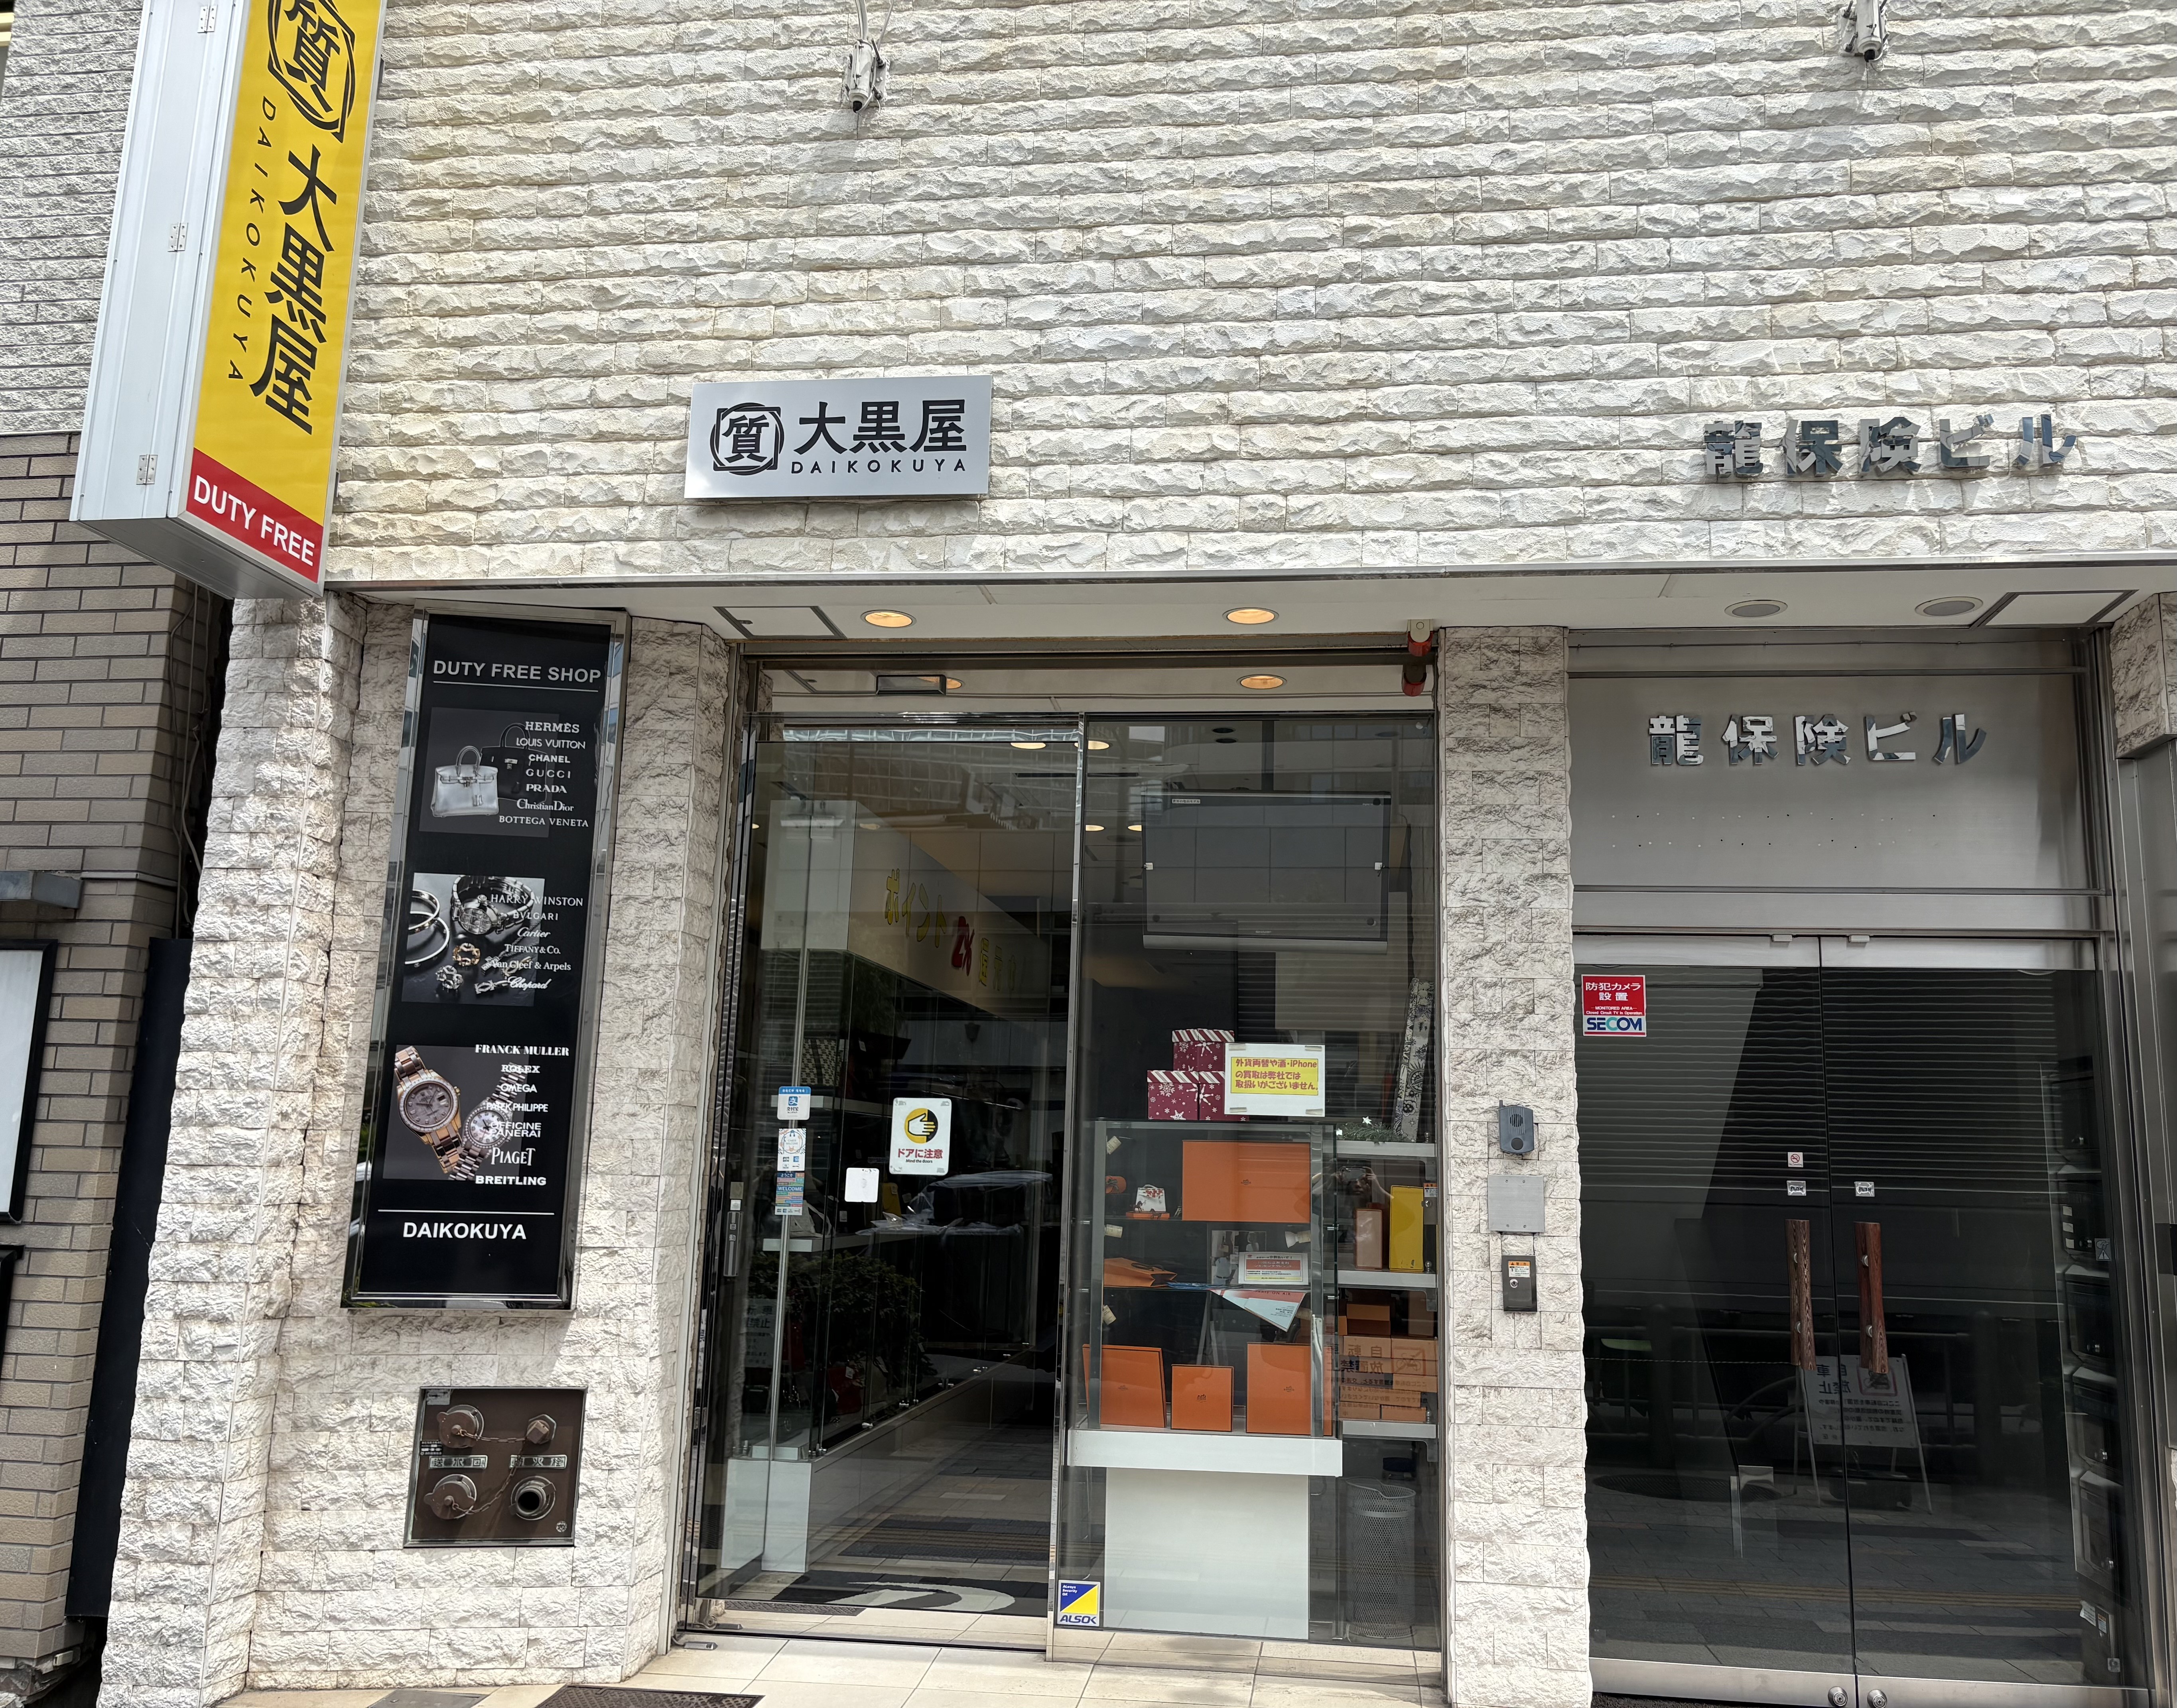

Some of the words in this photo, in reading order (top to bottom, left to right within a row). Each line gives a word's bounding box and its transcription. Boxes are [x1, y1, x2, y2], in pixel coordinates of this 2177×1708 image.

[227, 94, 277, 381] DAIKOKUYA
[249, 142, 338, 435] 大黒屋
[793, 399, 967, 455] 大黒屋
[722, 414, 769, 463] 質
[1704, 414, 2077, 475] 龍保険ビル
[791, 459, 966, 474] DAIKOKUYA
[193, 474, 256, 533] DUTY
[261, 519, 316, 567] FREE
[433, 660, 485, 677] DUTY
[491, 664, 541, 679] FREE
[548, 667, 601, 683] SHOP
[516, 737, 542, 747] LOUIS
[546, 738, 586, 750] VUITTON
[1649, 712, 1987, 766] 龍保険ビル
[528, 754, 571, 763] CHANEL
[526, 768, 571, 779] GUCCI
[526, 784, 567, 794] PRADA
[499, 815, 546, 826] BOTTEGA
[549, 817, 589, 827] VENETA
[491, 893, 528, 904] HARRY
[533, 896, 583, 907] WINSTON
[513, 912, 559, 921] BVLGARI
[517, 927, 551, 938] Cartier
[508, 960, 533, 970] Cleef
[543, 962, 571, 972] Arpels
[507, 976, 552, 990] Chopard
[1585, 982, 1641, 991] 防犯カメラ
[1599, 992, 1628, 1001] 設置
[1587, 1017, 1642, 1031] SECOM
[475, 1044, 521, 1055] FRANCK
[523, 1046, 570, 1057] MULLER
[501, 1064, 540, 1074] ROLEX
[1235, 1070, 1301, 1080] の買取は弊社では
[500, 1083, 538, 1093] OMEGA
[486, 1102, 512, 1111] PATEK
[512, 1103, 549, 1112] PHILIPPE
[490, 1121, 542, 1130] OFFICINE
[489, 1129, 541, 1138] PANERAI
[491, 1147, 536, 1166] PIAGET
[898, 1148, 943, 1159] ドアに注意
[475, 1175, 547, 1186] BREITLING
[403, 1222, 526, 1240] DAIKOKUYA
[1060, 1615, 1097, 1624] ALSOK
